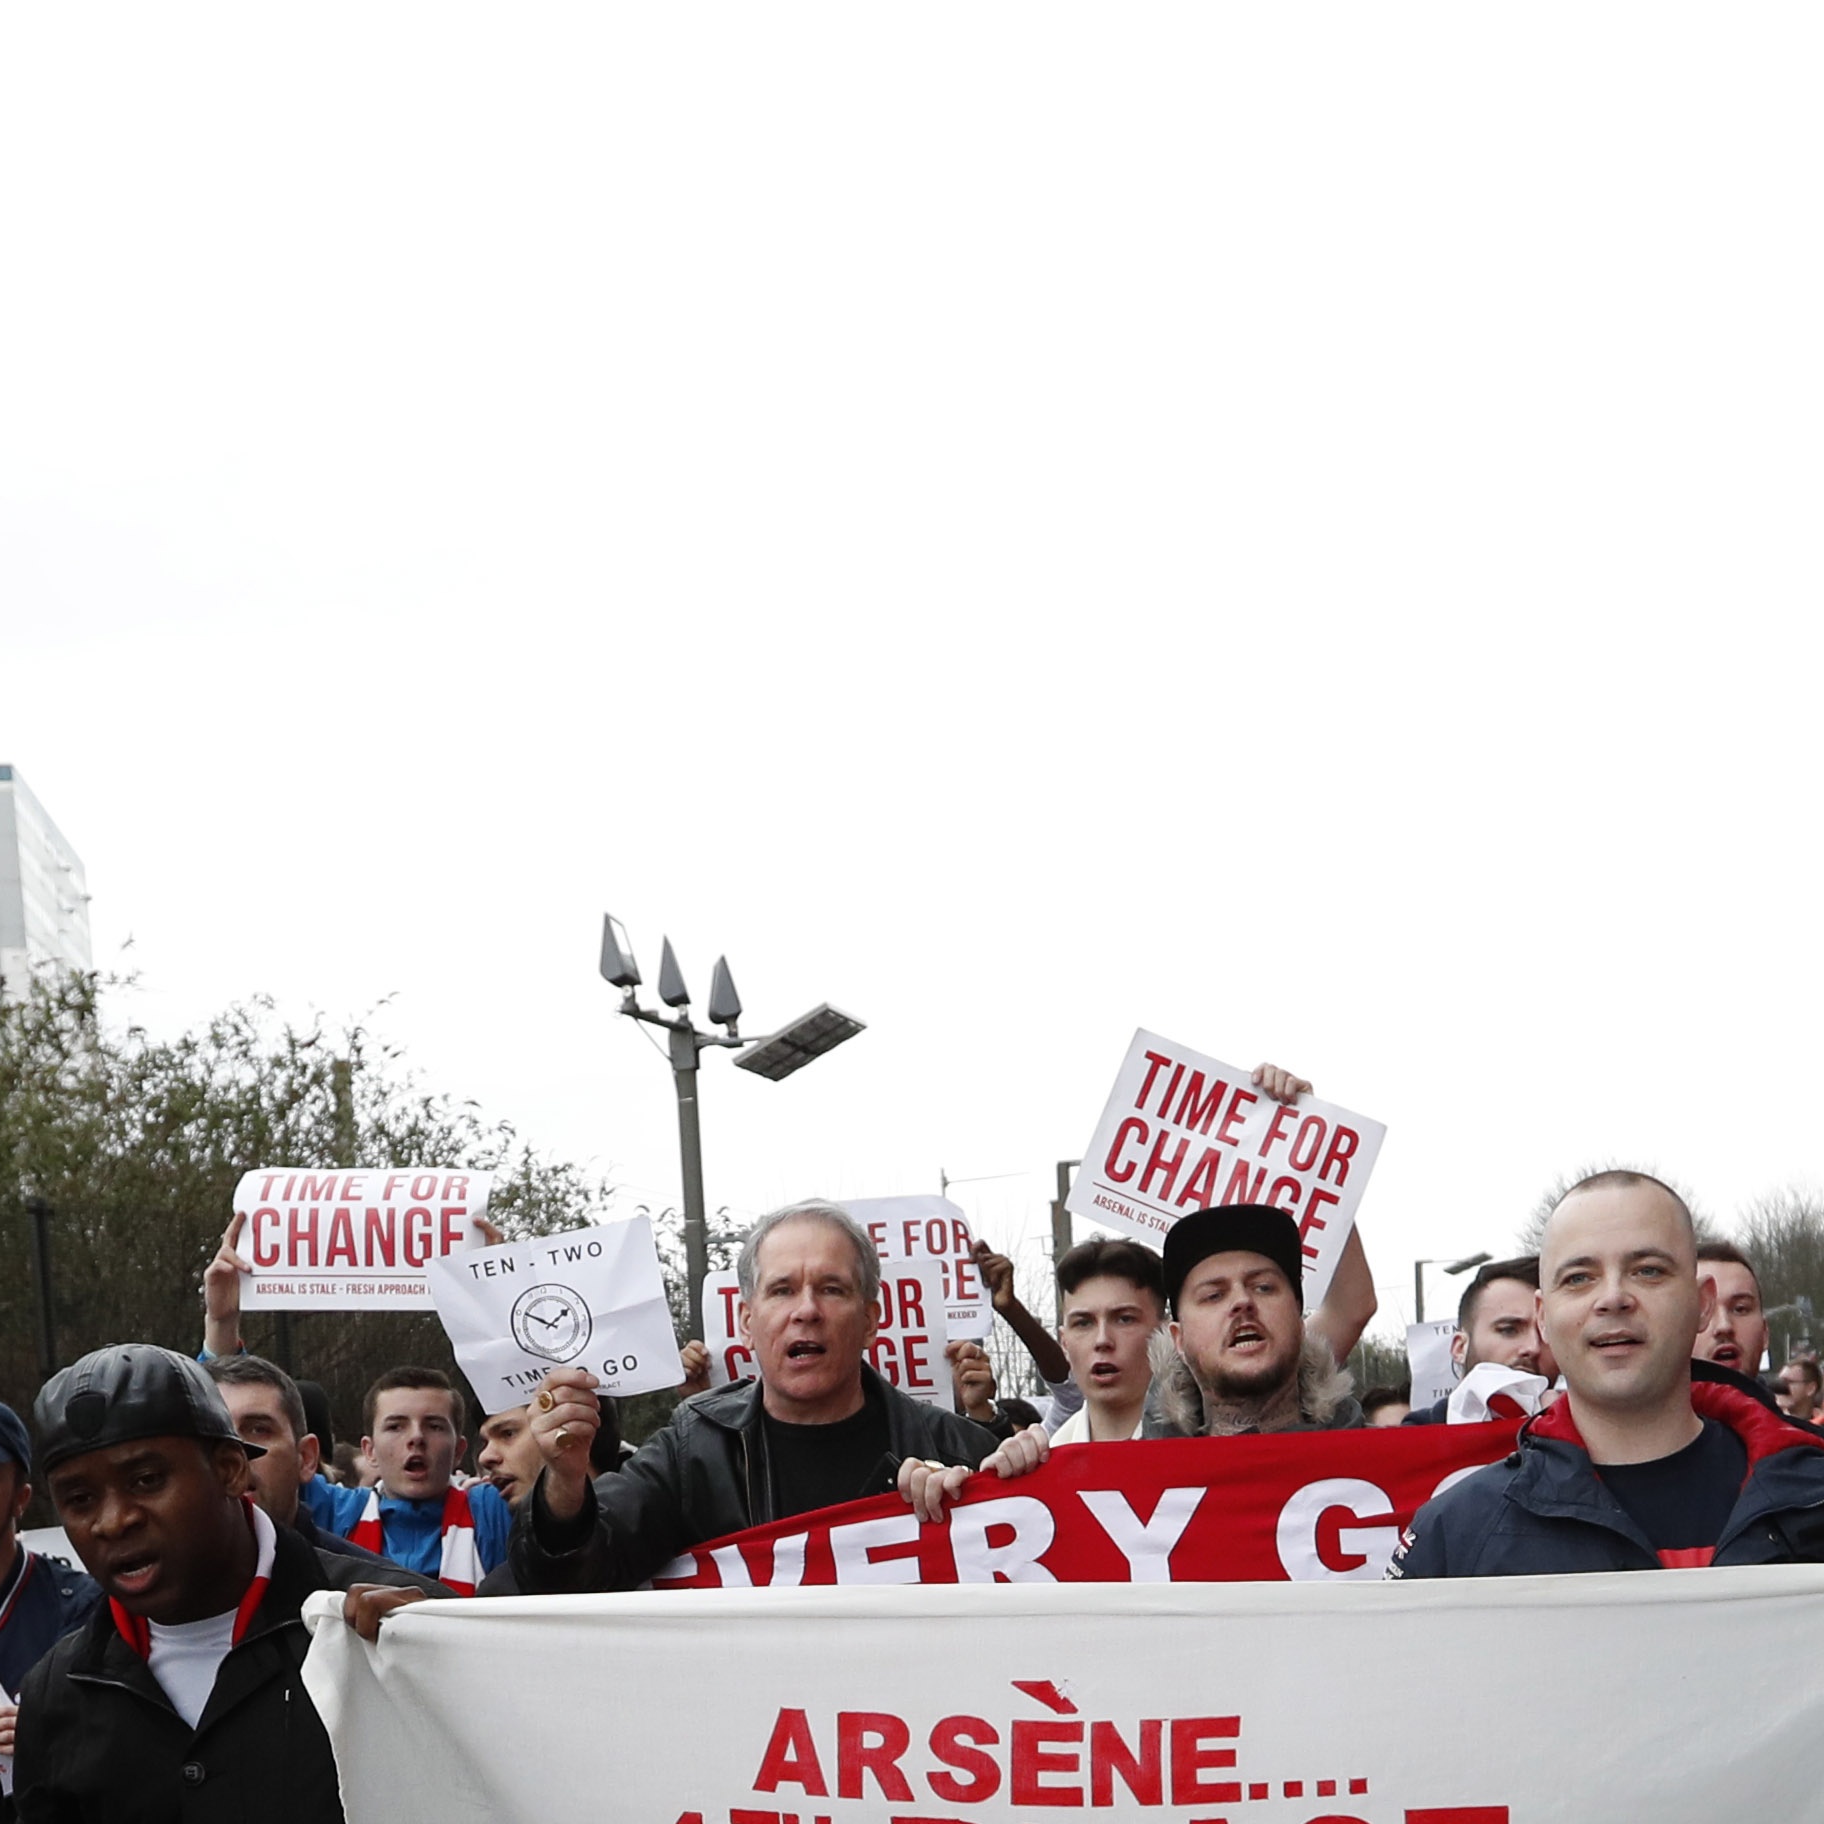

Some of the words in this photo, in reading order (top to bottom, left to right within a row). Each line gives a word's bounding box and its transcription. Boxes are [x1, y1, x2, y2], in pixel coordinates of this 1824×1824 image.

[1133, 1049, 1259, 1148] TIME
[1259, 1104, 1360, 1188] FOR
[259, 1174, 370, 1202] TIME
[382, 1174, 471, 1202] FOR
[1147, 1216, 1171, 1234] STAL
[469, 1257, 516, 1280] TEN
[547, 1241, 603, 1266] TWO
[603, 1355, 639, 1376] GO
